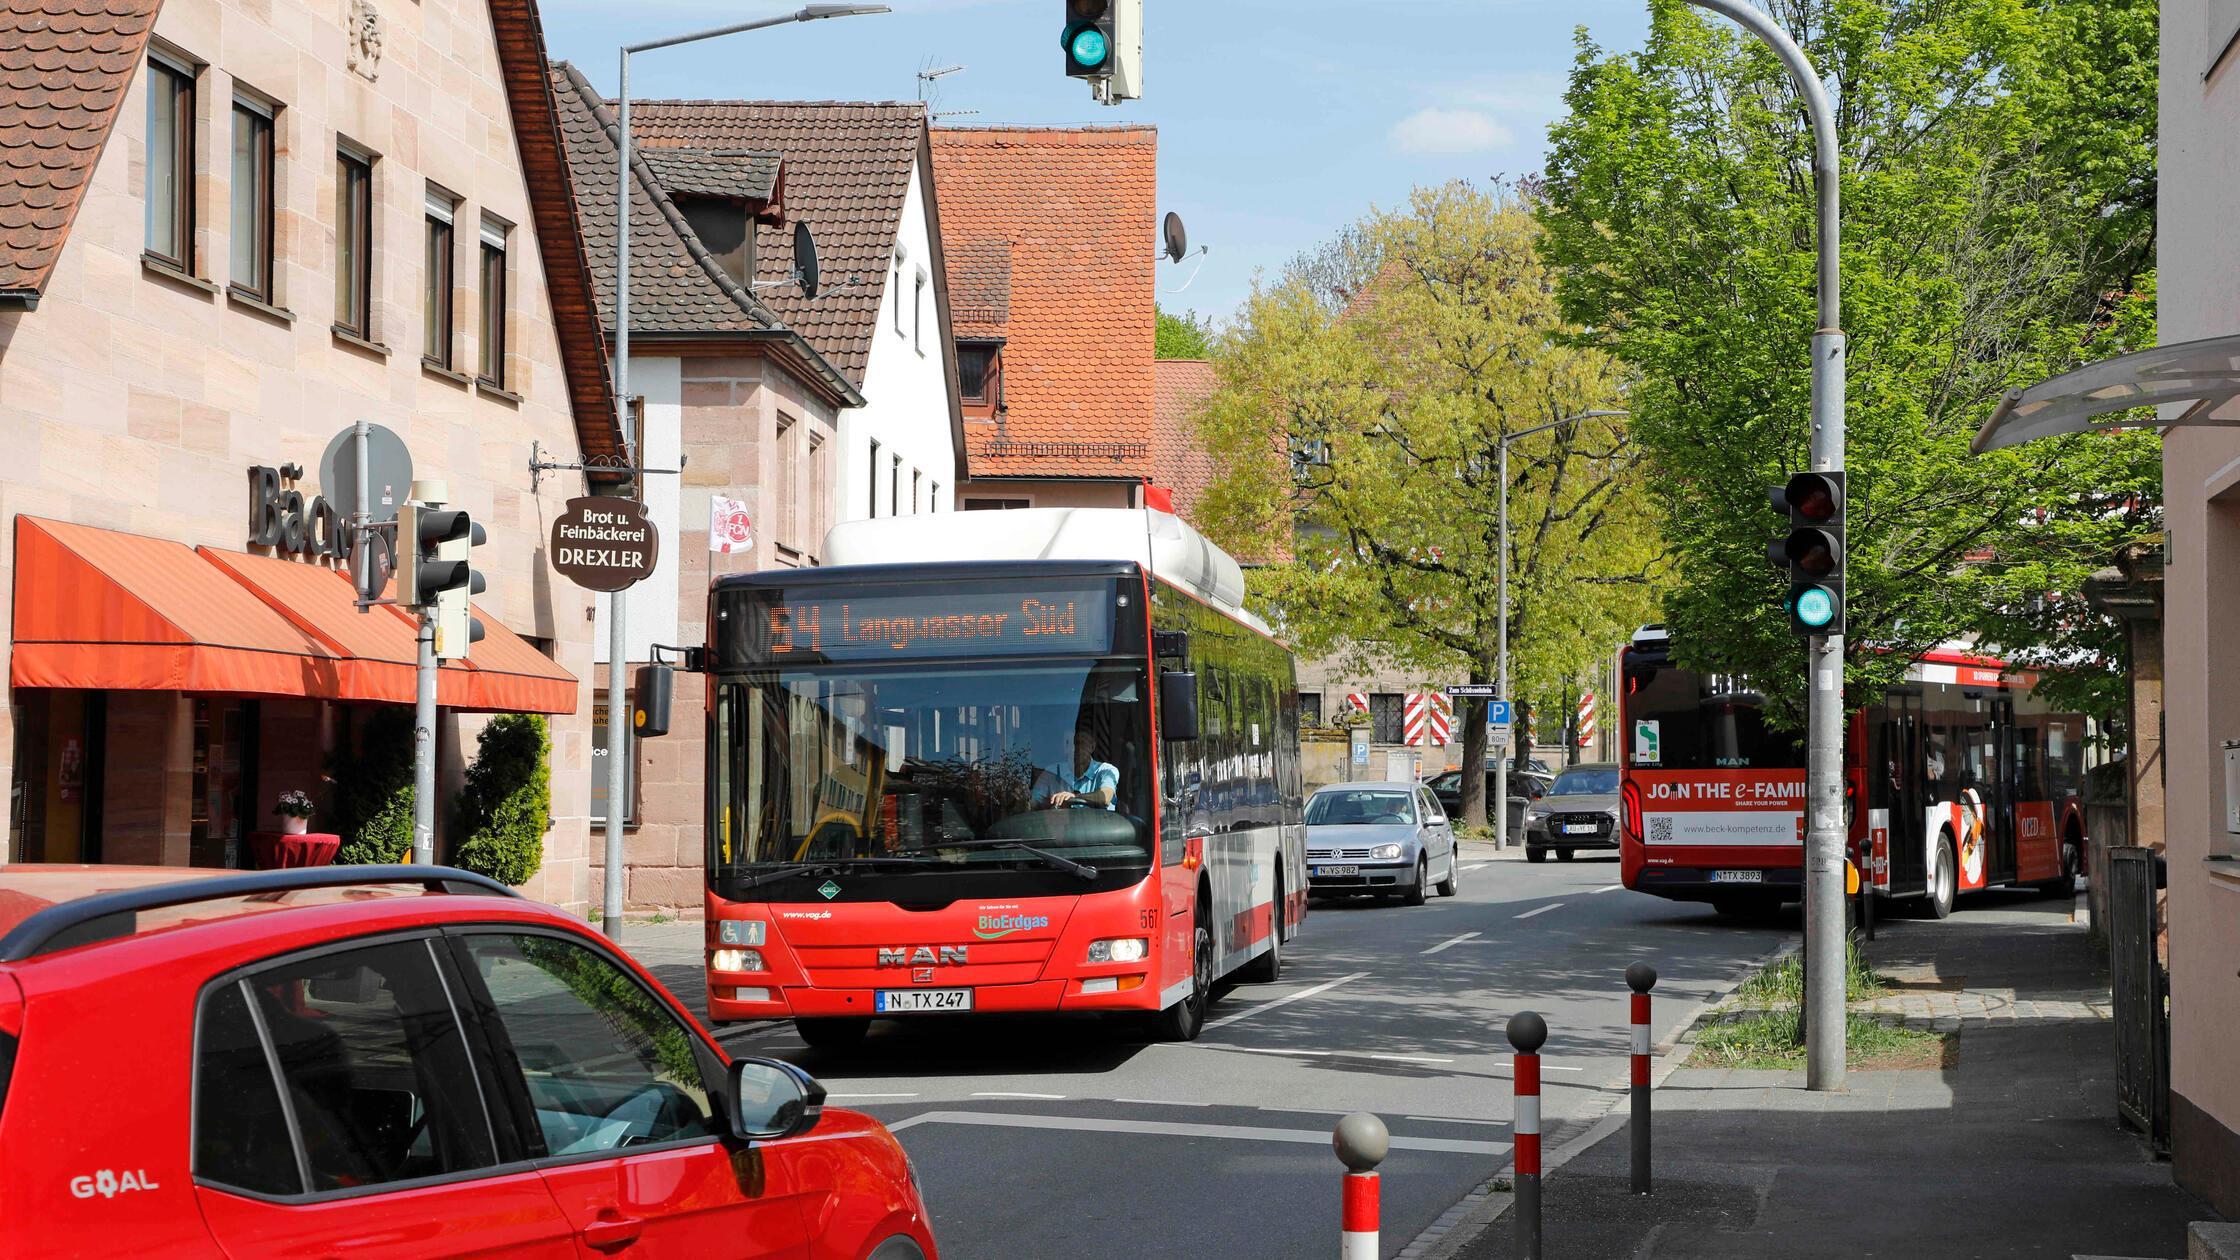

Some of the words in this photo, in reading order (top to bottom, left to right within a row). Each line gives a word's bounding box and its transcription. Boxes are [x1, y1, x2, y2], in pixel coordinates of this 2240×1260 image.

[583, 509, 614, 524] Brot
[617, 514, 629, 525] u.
[560, 524, 645, 542] Feinbäckerei
[559, 548, 644, 569] DREXLER
[770, 605, 821, 653] 54
[842, 604, 1008, 649] Langwasser
[1021, 599, 1076, 636] Süd
[1493, 704, 1505, 721] P
[1716, 758, 1750, 766] MAN
[1694, 782, 1731, 799] THE
[1683, 823, 1787, 834] www.beck-kompetenz.de
[1320, 867, 1326, 875] N
[1330, 867, 1340, 875] YS
[1341, 866, 1356, 874] 982
[1716, 872, 1722, 881] N
[1727, 872, 1738, 881] TX
[1739, 871, 1761, 881] 3893
[978, 914, 1049, 930] BioErdgas
[1139, 909, 1158, 929] 567
[879, 945, 968, 966] MAN
[891, 993, 902, 1009] N
[912, 993, 932, 1008] TX
[936, 992, 964, 1008] 247
[70, 1168, 160, 1199] GOAL
